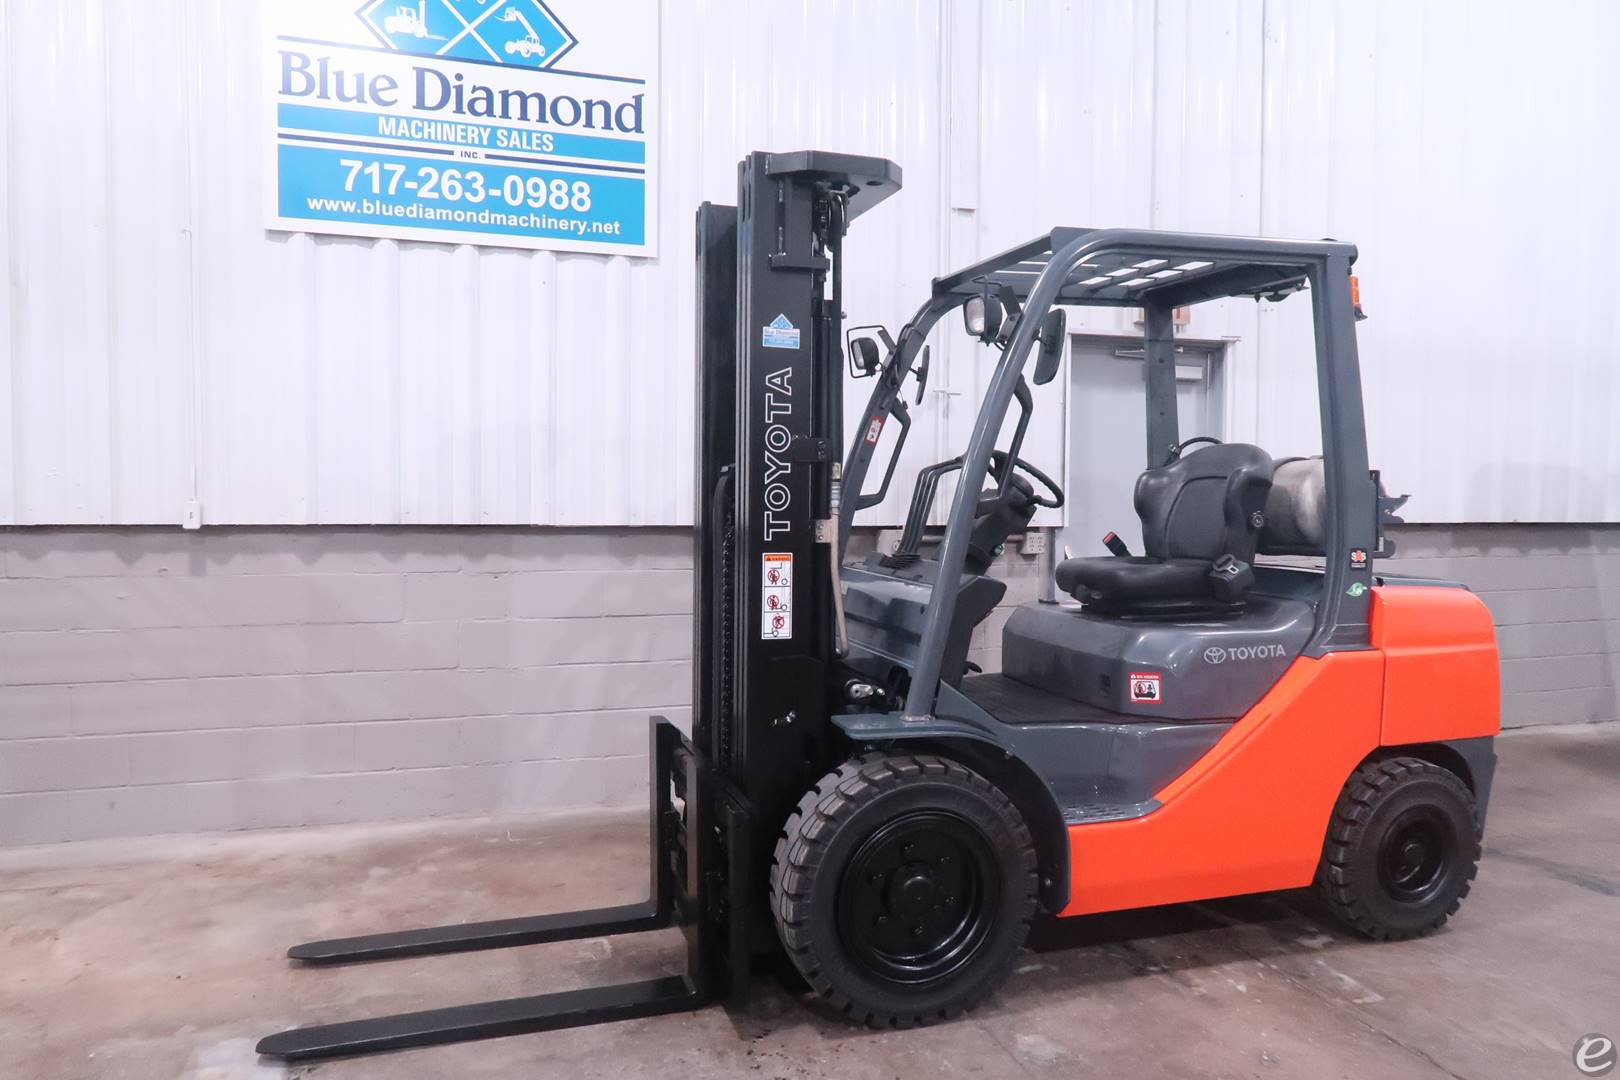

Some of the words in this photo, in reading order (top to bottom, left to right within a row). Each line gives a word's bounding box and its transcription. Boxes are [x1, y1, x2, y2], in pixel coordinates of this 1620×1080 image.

[277, 50, 399, 107] Blue
[412, 66, 645, 134] Diamond
[378, 116, 492, 146] MACHINERY
[496, 129, 554, 152] SALES
[460, 150, 482, 160] INC.
[339, 159, 592, 213] 717-263-0988
[307, 197, 621, 236] www.bluediamondmachinery.net
[764, 367, 793, 541] TOYOTA
[1228, 644, 1286, 661] TOYOTA
